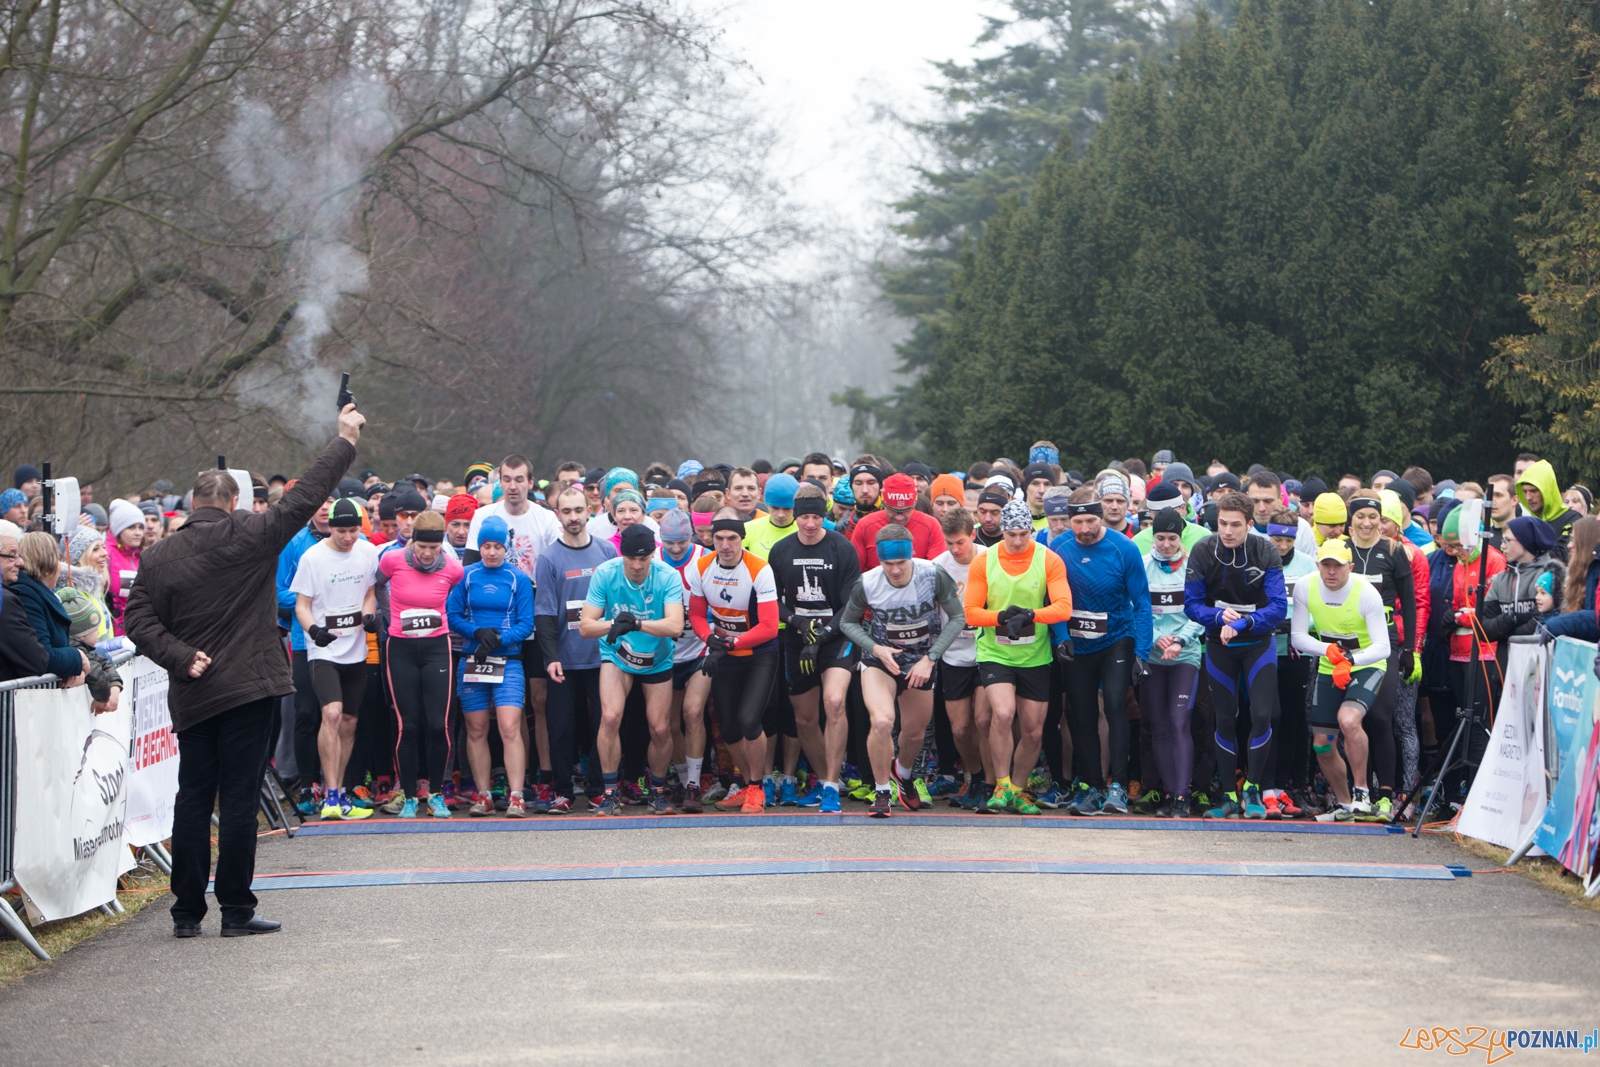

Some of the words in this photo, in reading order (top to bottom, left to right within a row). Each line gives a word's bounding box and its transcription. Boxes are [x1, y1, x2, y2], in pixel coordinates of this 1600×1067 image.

[887, 492, 909, 500] VITAL
[1160, 594, 1173, 604] 54
[337, 616, 354, 627] 540
[412, 617, 431, 628] 511
[719, 620, 737, 630] 519
[1078, 620, 1097, 630] 753
[898, 630, 918, 639] 615
[625, 654, 644, 664] 530
[475, 664, 494, 673] 273
